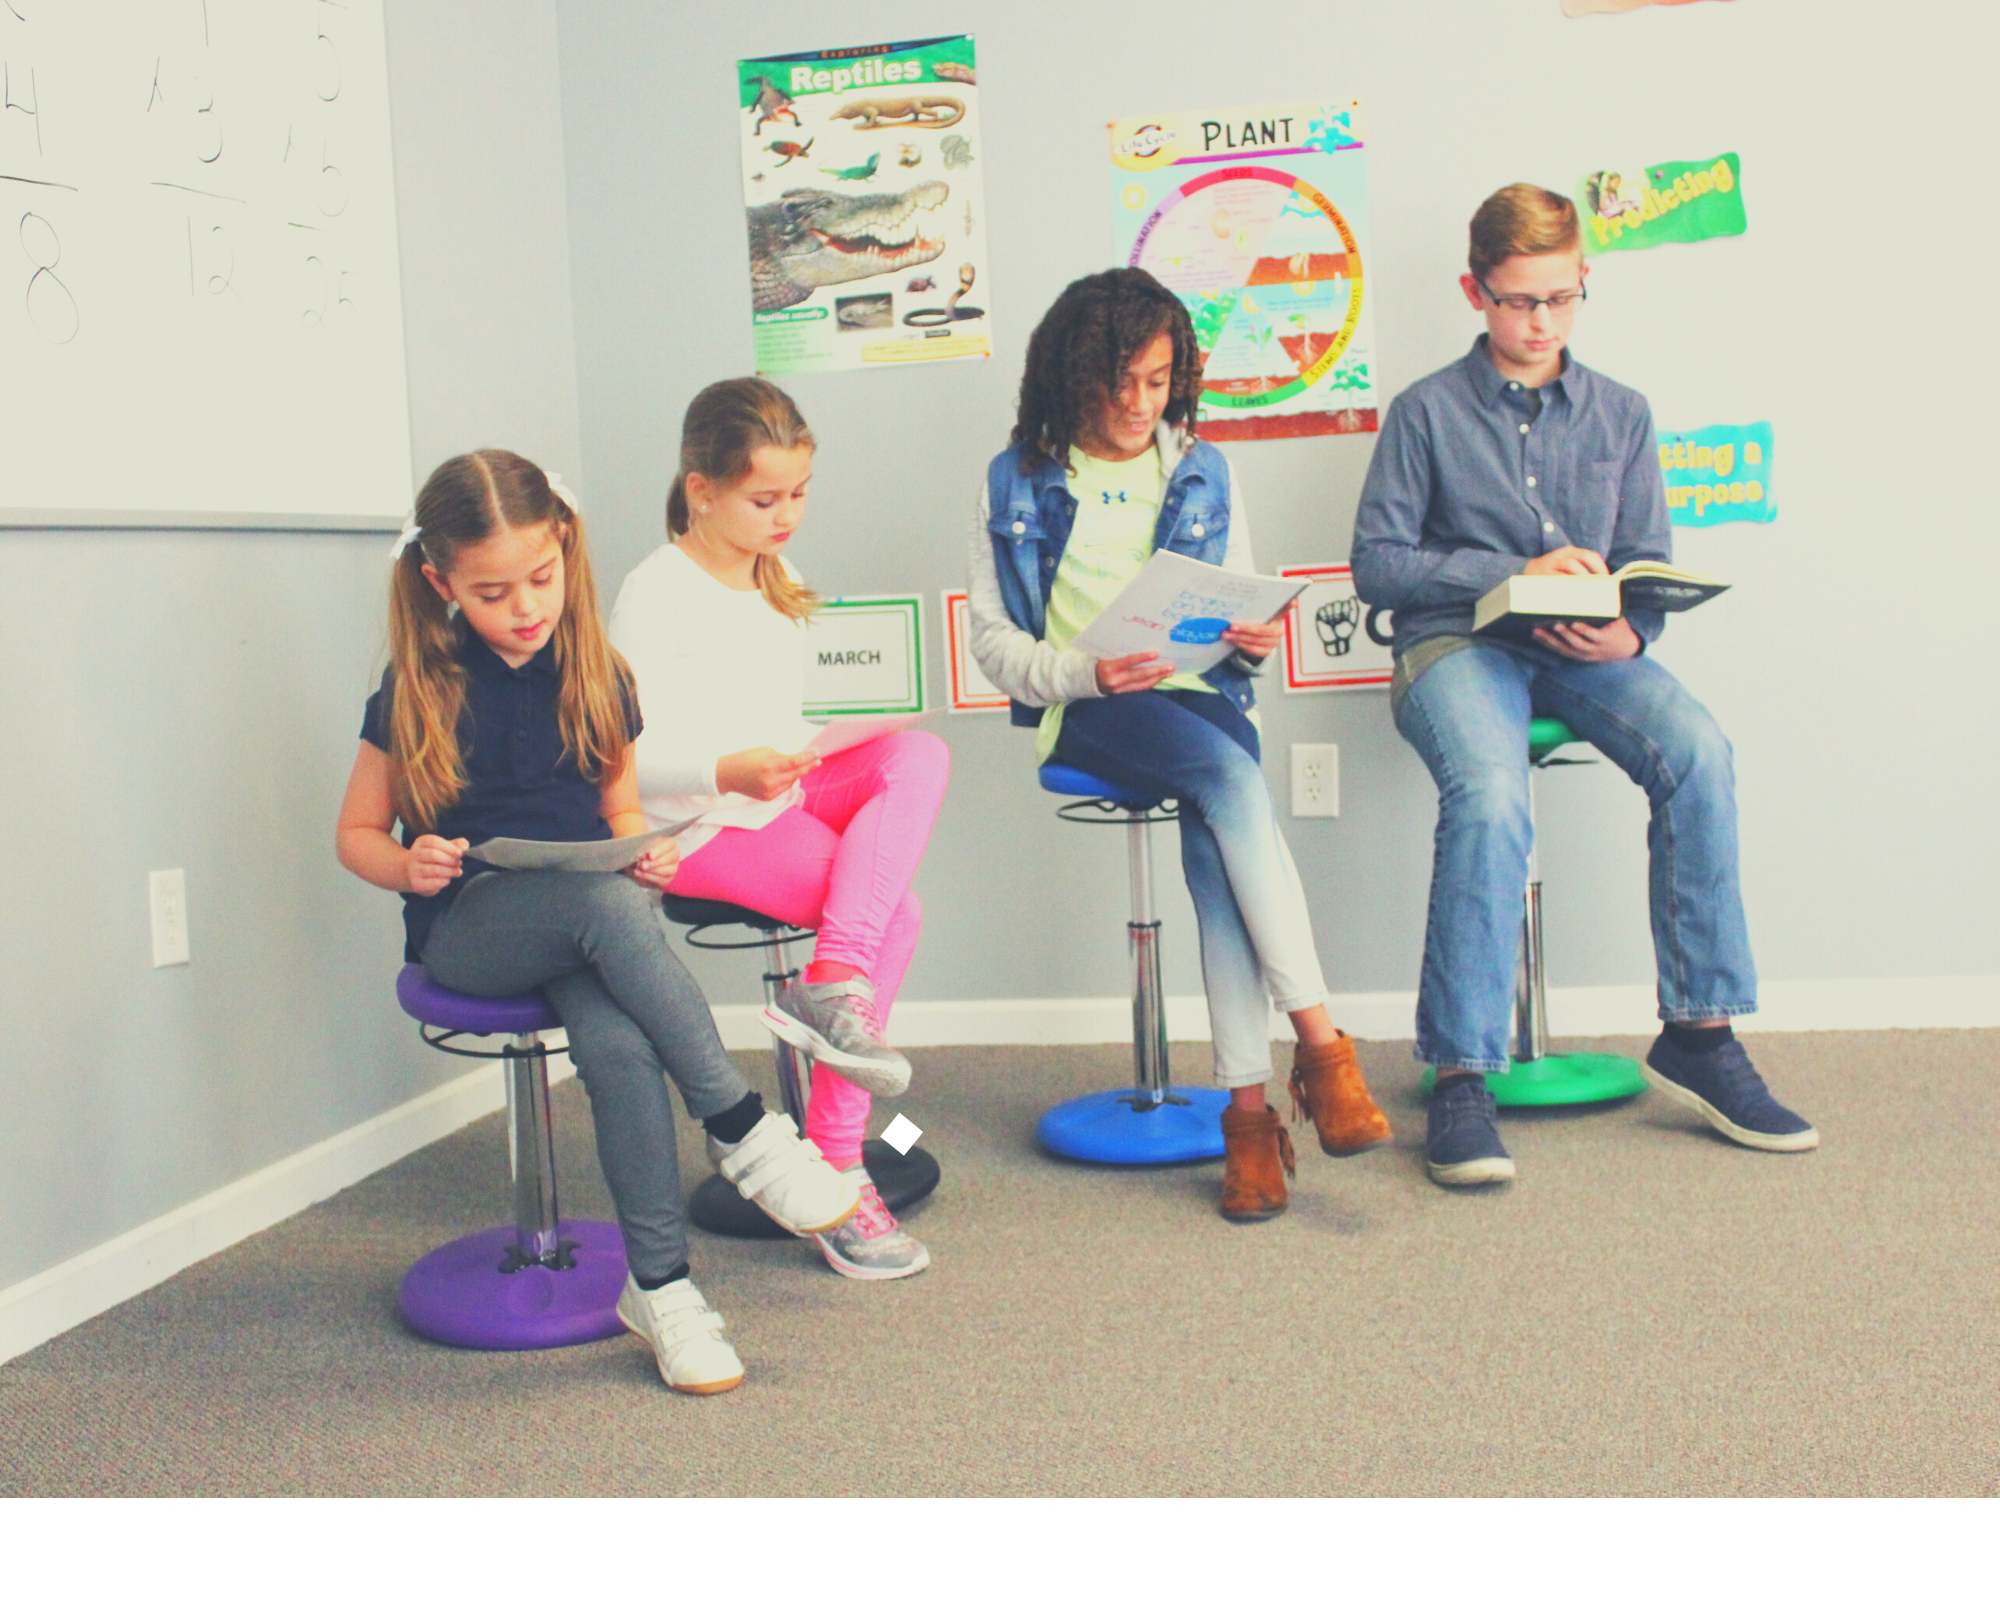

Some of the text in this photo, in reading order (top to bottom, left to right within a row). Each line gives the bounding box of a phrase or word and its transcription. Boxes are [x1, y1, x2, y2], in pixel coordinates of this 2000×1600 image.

[790, 59, 922, 94] Reptiles
[4, 60, 43, 156] 4
[1200, 117, 1294, 151] PLANT
[1311, 192, 1356, 254] GERMINATION
[1590, 159, 1734, 245] Predicting
[1128, 209, 1162, 265] OLLINATION
[20, 211, 79, 345] 8
[1309, 287, 1362, 379] STEMS AND ROOTS
[1658, 440, 1763, 477] tting a
[1664, 480, 1764, 516] urpose
[817, 649, 881, 666] MARCH
